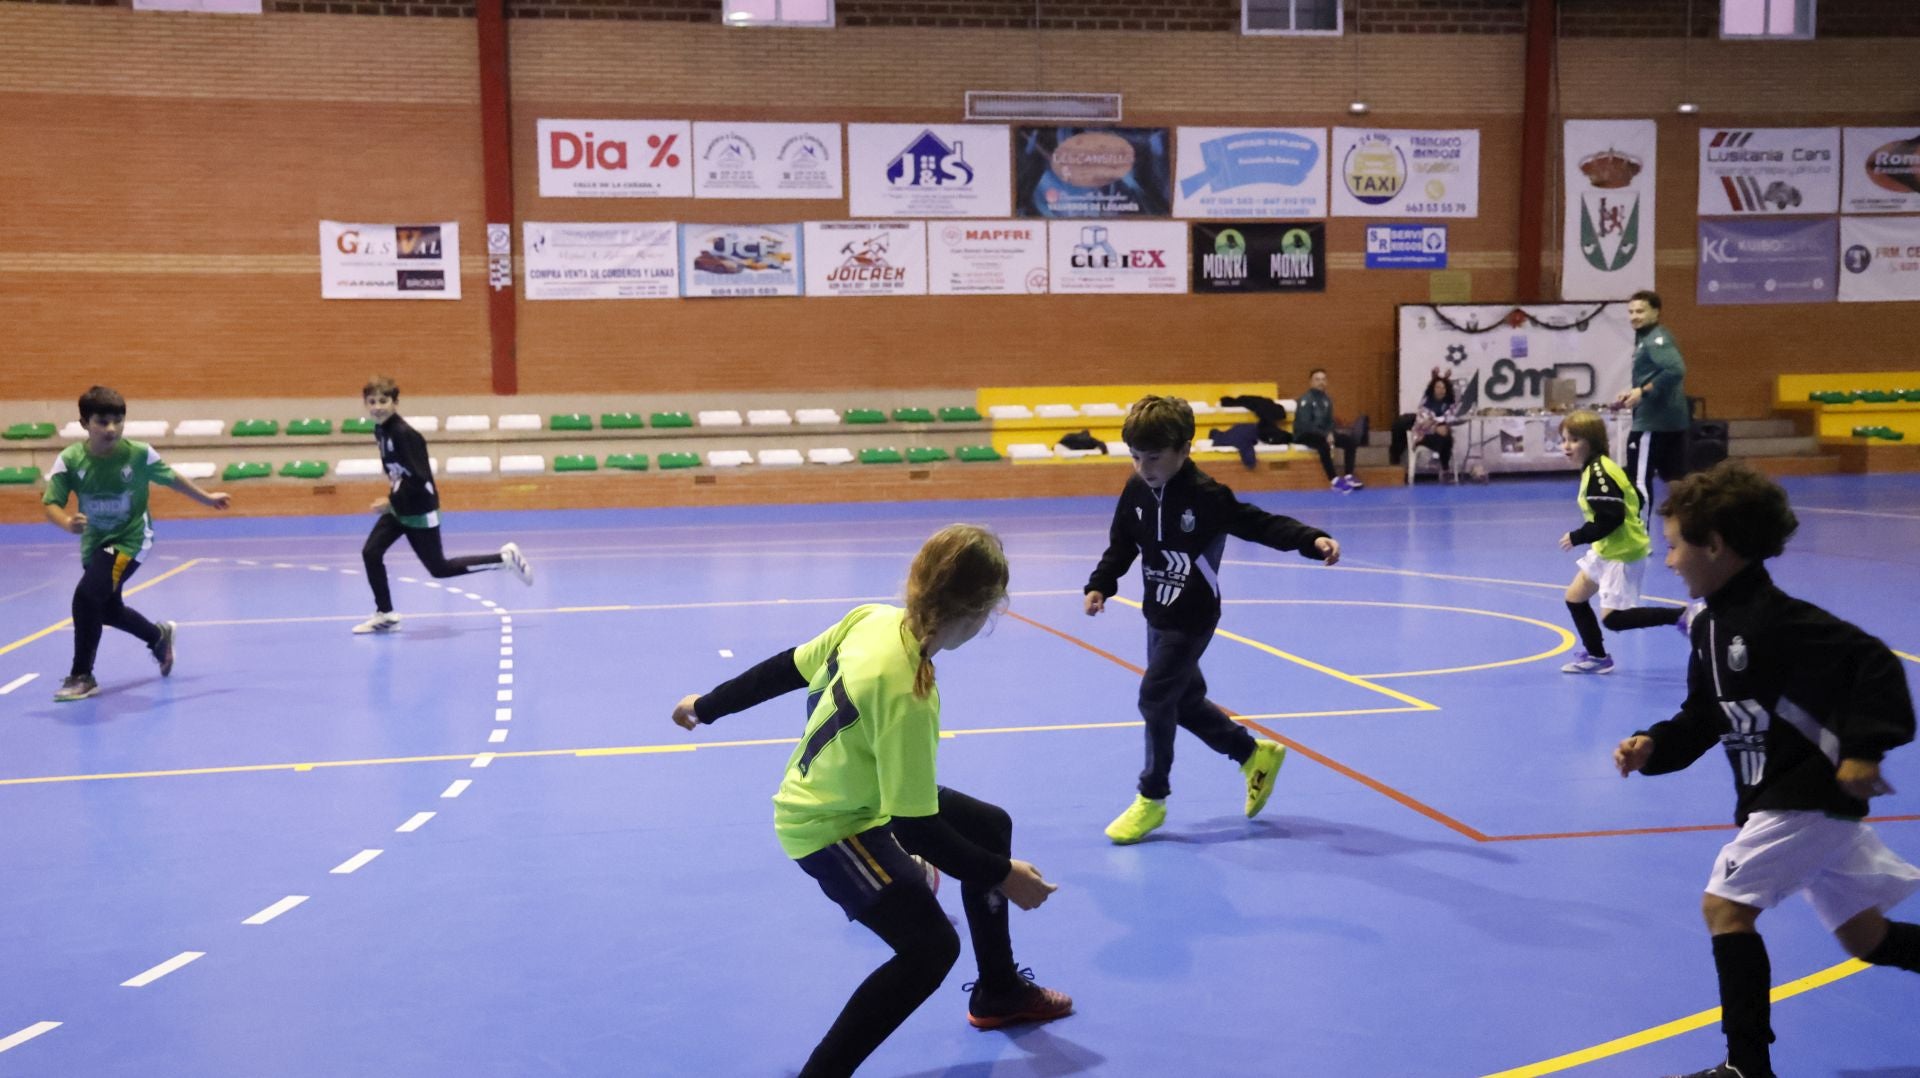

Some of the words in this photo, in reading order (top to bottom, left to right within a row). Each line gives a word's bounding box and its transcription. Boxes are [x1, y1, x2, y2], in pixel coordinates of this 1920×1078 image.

[551, 131, 627, 170] Dia
[1707, 149, 1784, 162] Lusitania
[1792, 148, 1831, 161] Cars
[1353, 176, 1396, 191] TAXI
[966, 230, 1032, 240] MAPFRE
[530, 268, 562, 279] COMPRA
[564, 268, 588, 279] VENTA
[590, 268, 601, 279] DE
[643, 268, 649, 278] Y
[650, 267, 675, 278] LANAS
